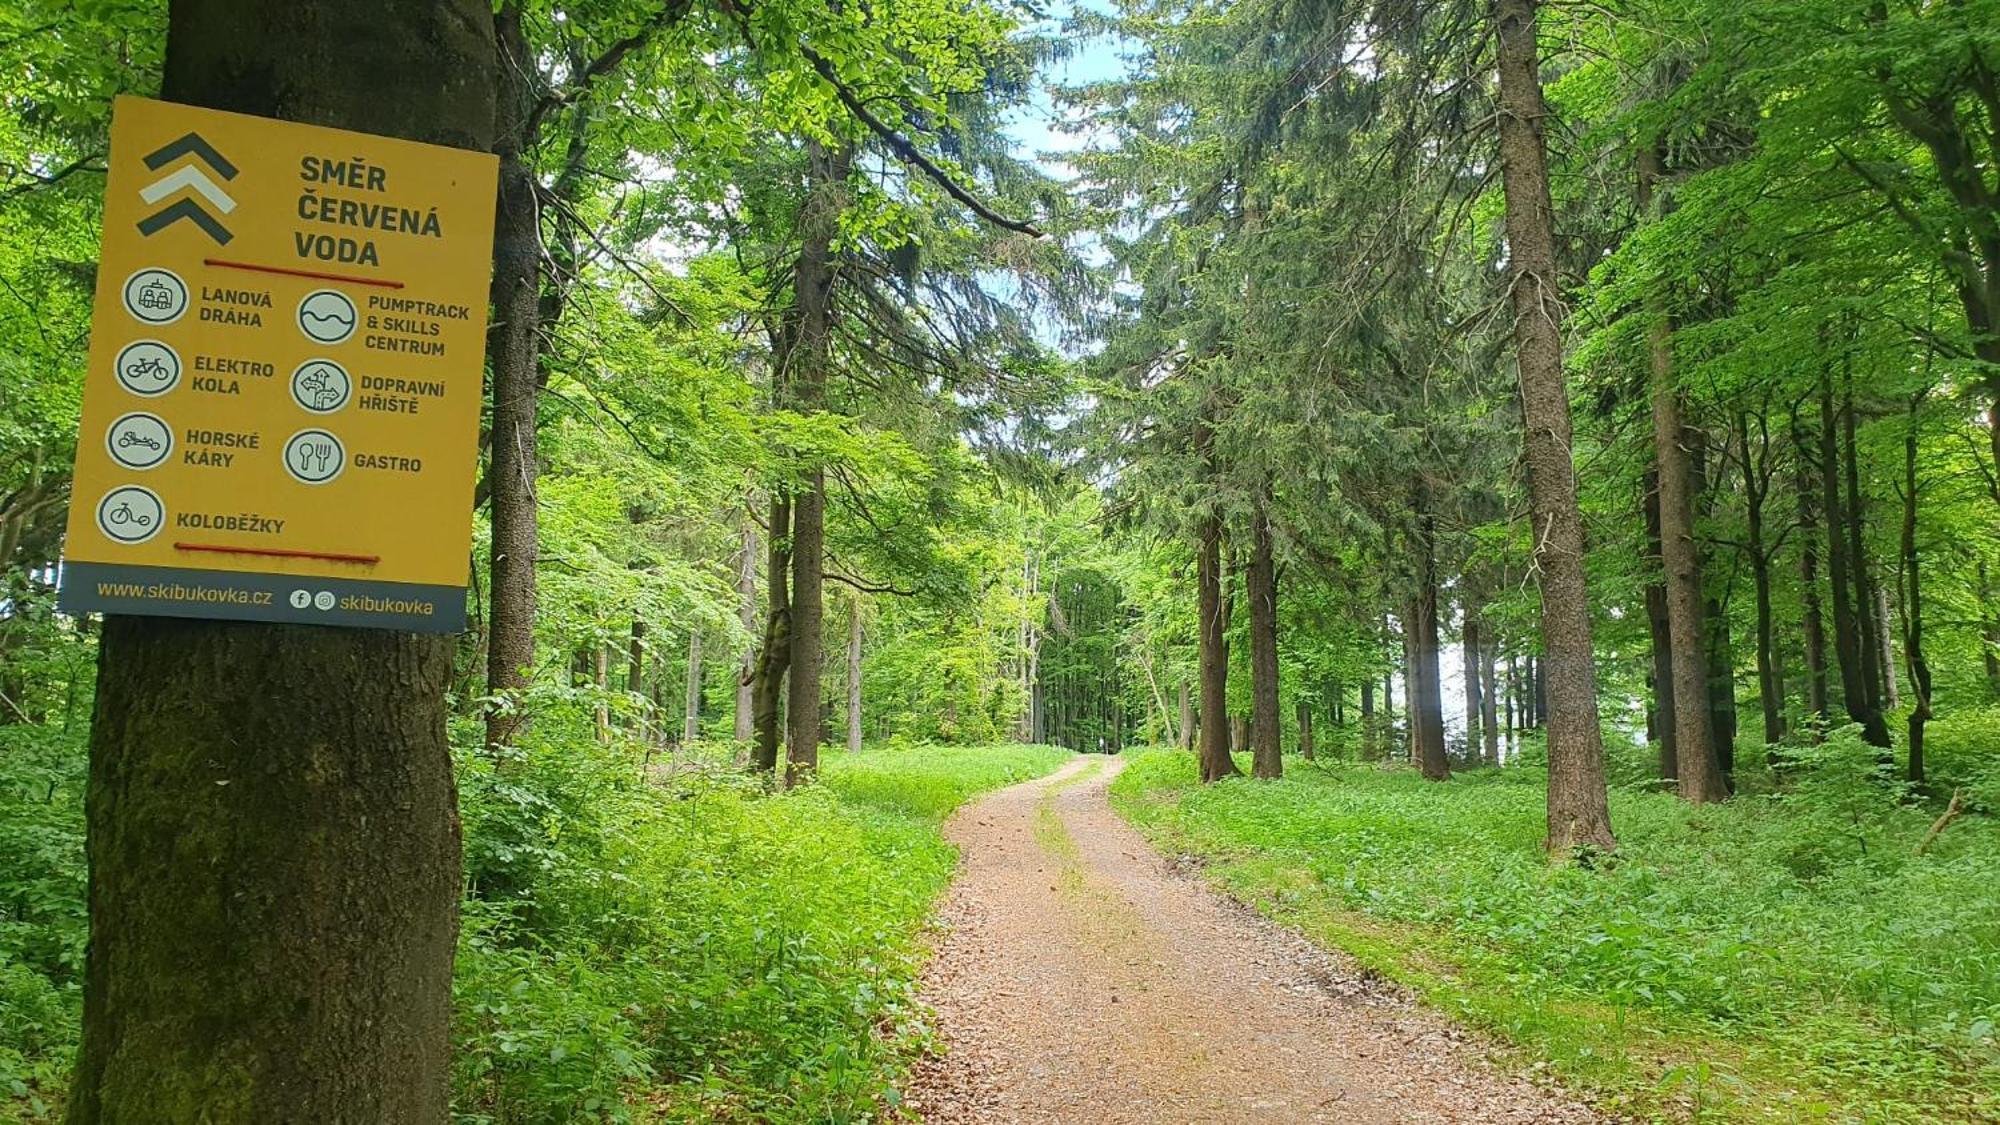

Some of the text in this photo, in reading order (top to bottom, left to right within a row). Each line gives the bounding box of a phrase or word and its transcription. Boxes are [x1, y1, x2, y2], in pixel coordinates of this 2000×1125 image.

[301, 156, 386, 192] SMĚR
[298, 188, 441, 238] ČERVENÁ
[295, 231, 379, 267] VODA
[202, 286, 273, 308] LANOVÁ
[368, 295, 470, 320] PUMPTRACK
[200, 307, 262, 327] DRÁHA
[367, 315, 440, 336] & SKILLS
[365, 336, 445, 356] CENTRUM
[195, 356, 274, 377] ELEKTRO
[192, 377, 240, 394] KOLA
[361, 376, 445, 397] DOPRAVNÍ
[359, 393, 419, 414] HŘIŠTĚ
[186, 429, 260, 449] HORSKÉ
[184, 449, 234, 468] KÁRY
[354, 454, 421, 472] GASTRO
[177, 512, 285, 534] KOLOBĚŽKY
[98, 581, 273, 605] www.skibukovka.cz
[340, 595, 433, 615] skibukovka
